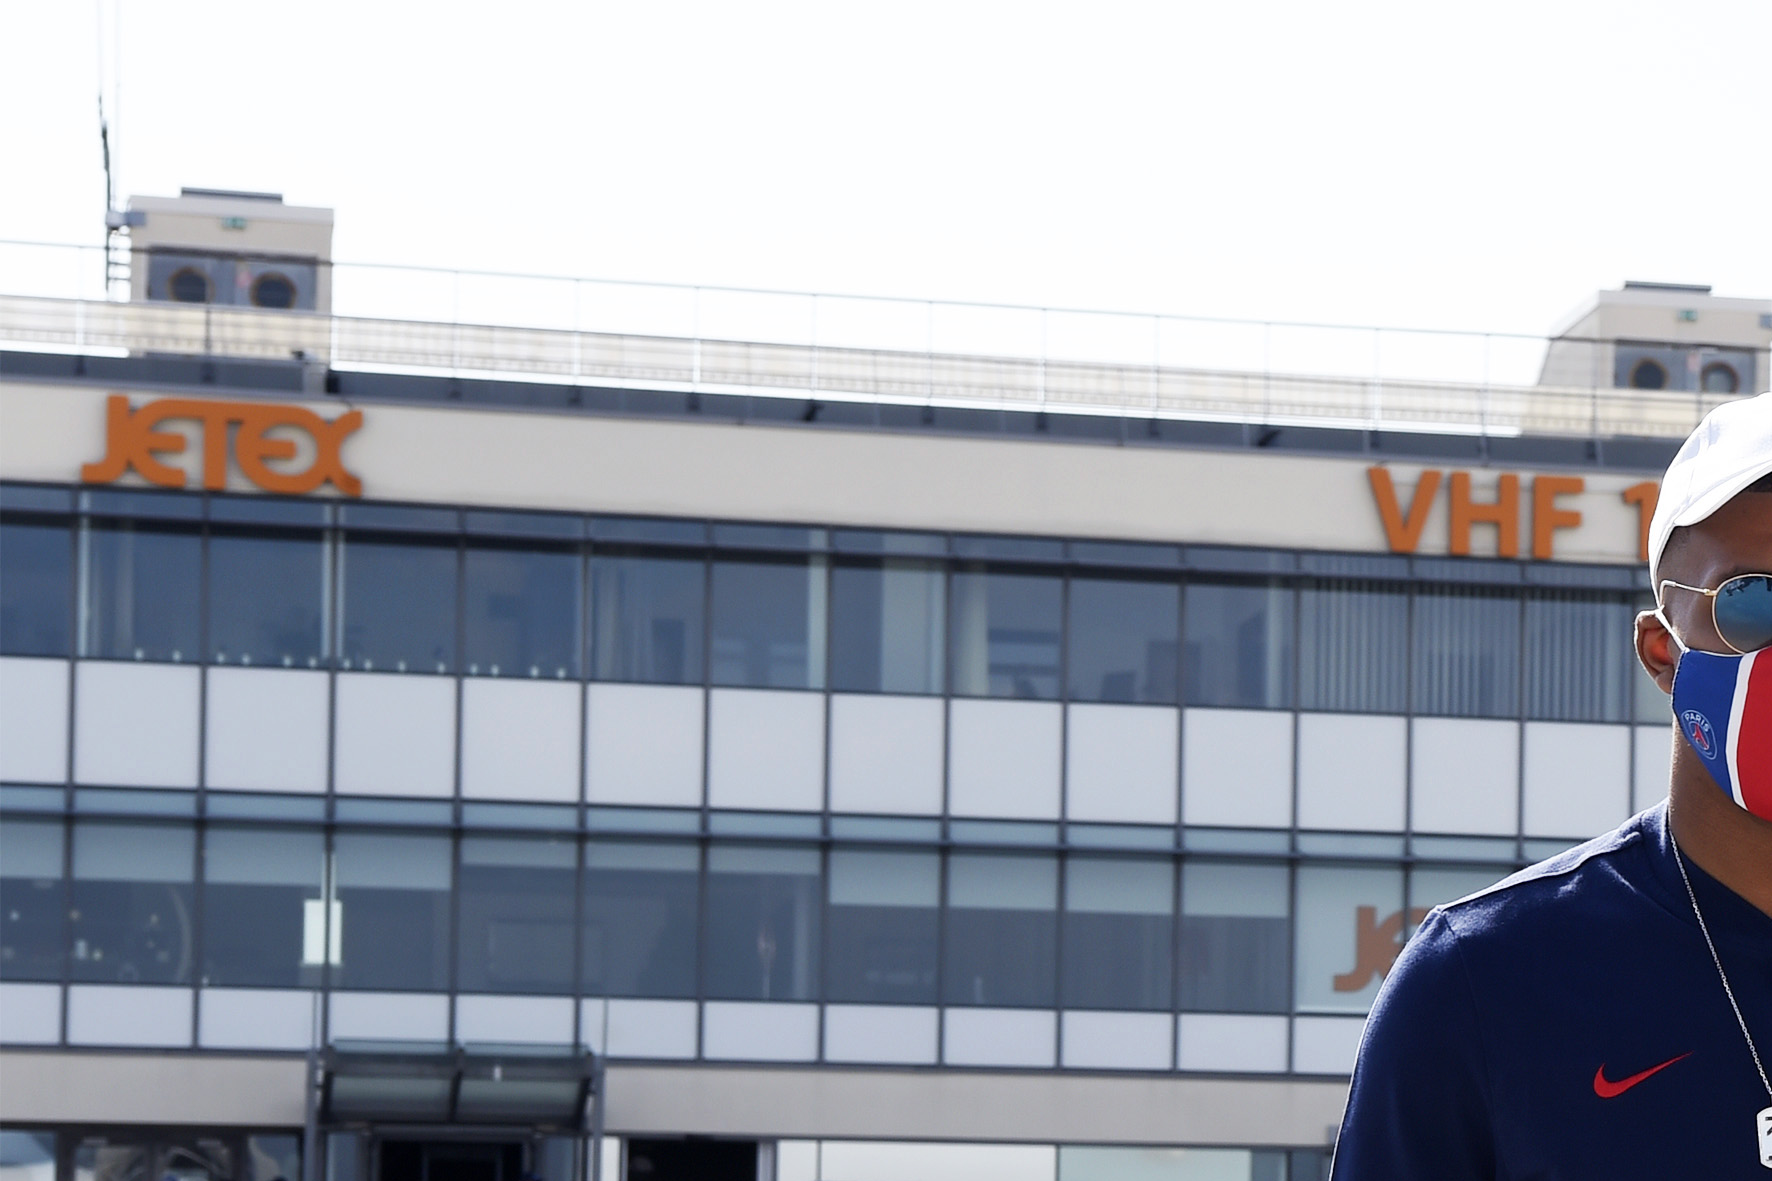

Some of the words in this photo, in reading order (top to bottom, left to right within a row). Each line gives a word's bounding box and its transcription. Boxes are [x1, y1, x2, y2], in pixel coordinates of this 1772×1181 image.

[81, 394, 363, 498] JETEX
[1367, 467, 1585, 560] VHF
[1684, 713, 1711, 732] PARIS
